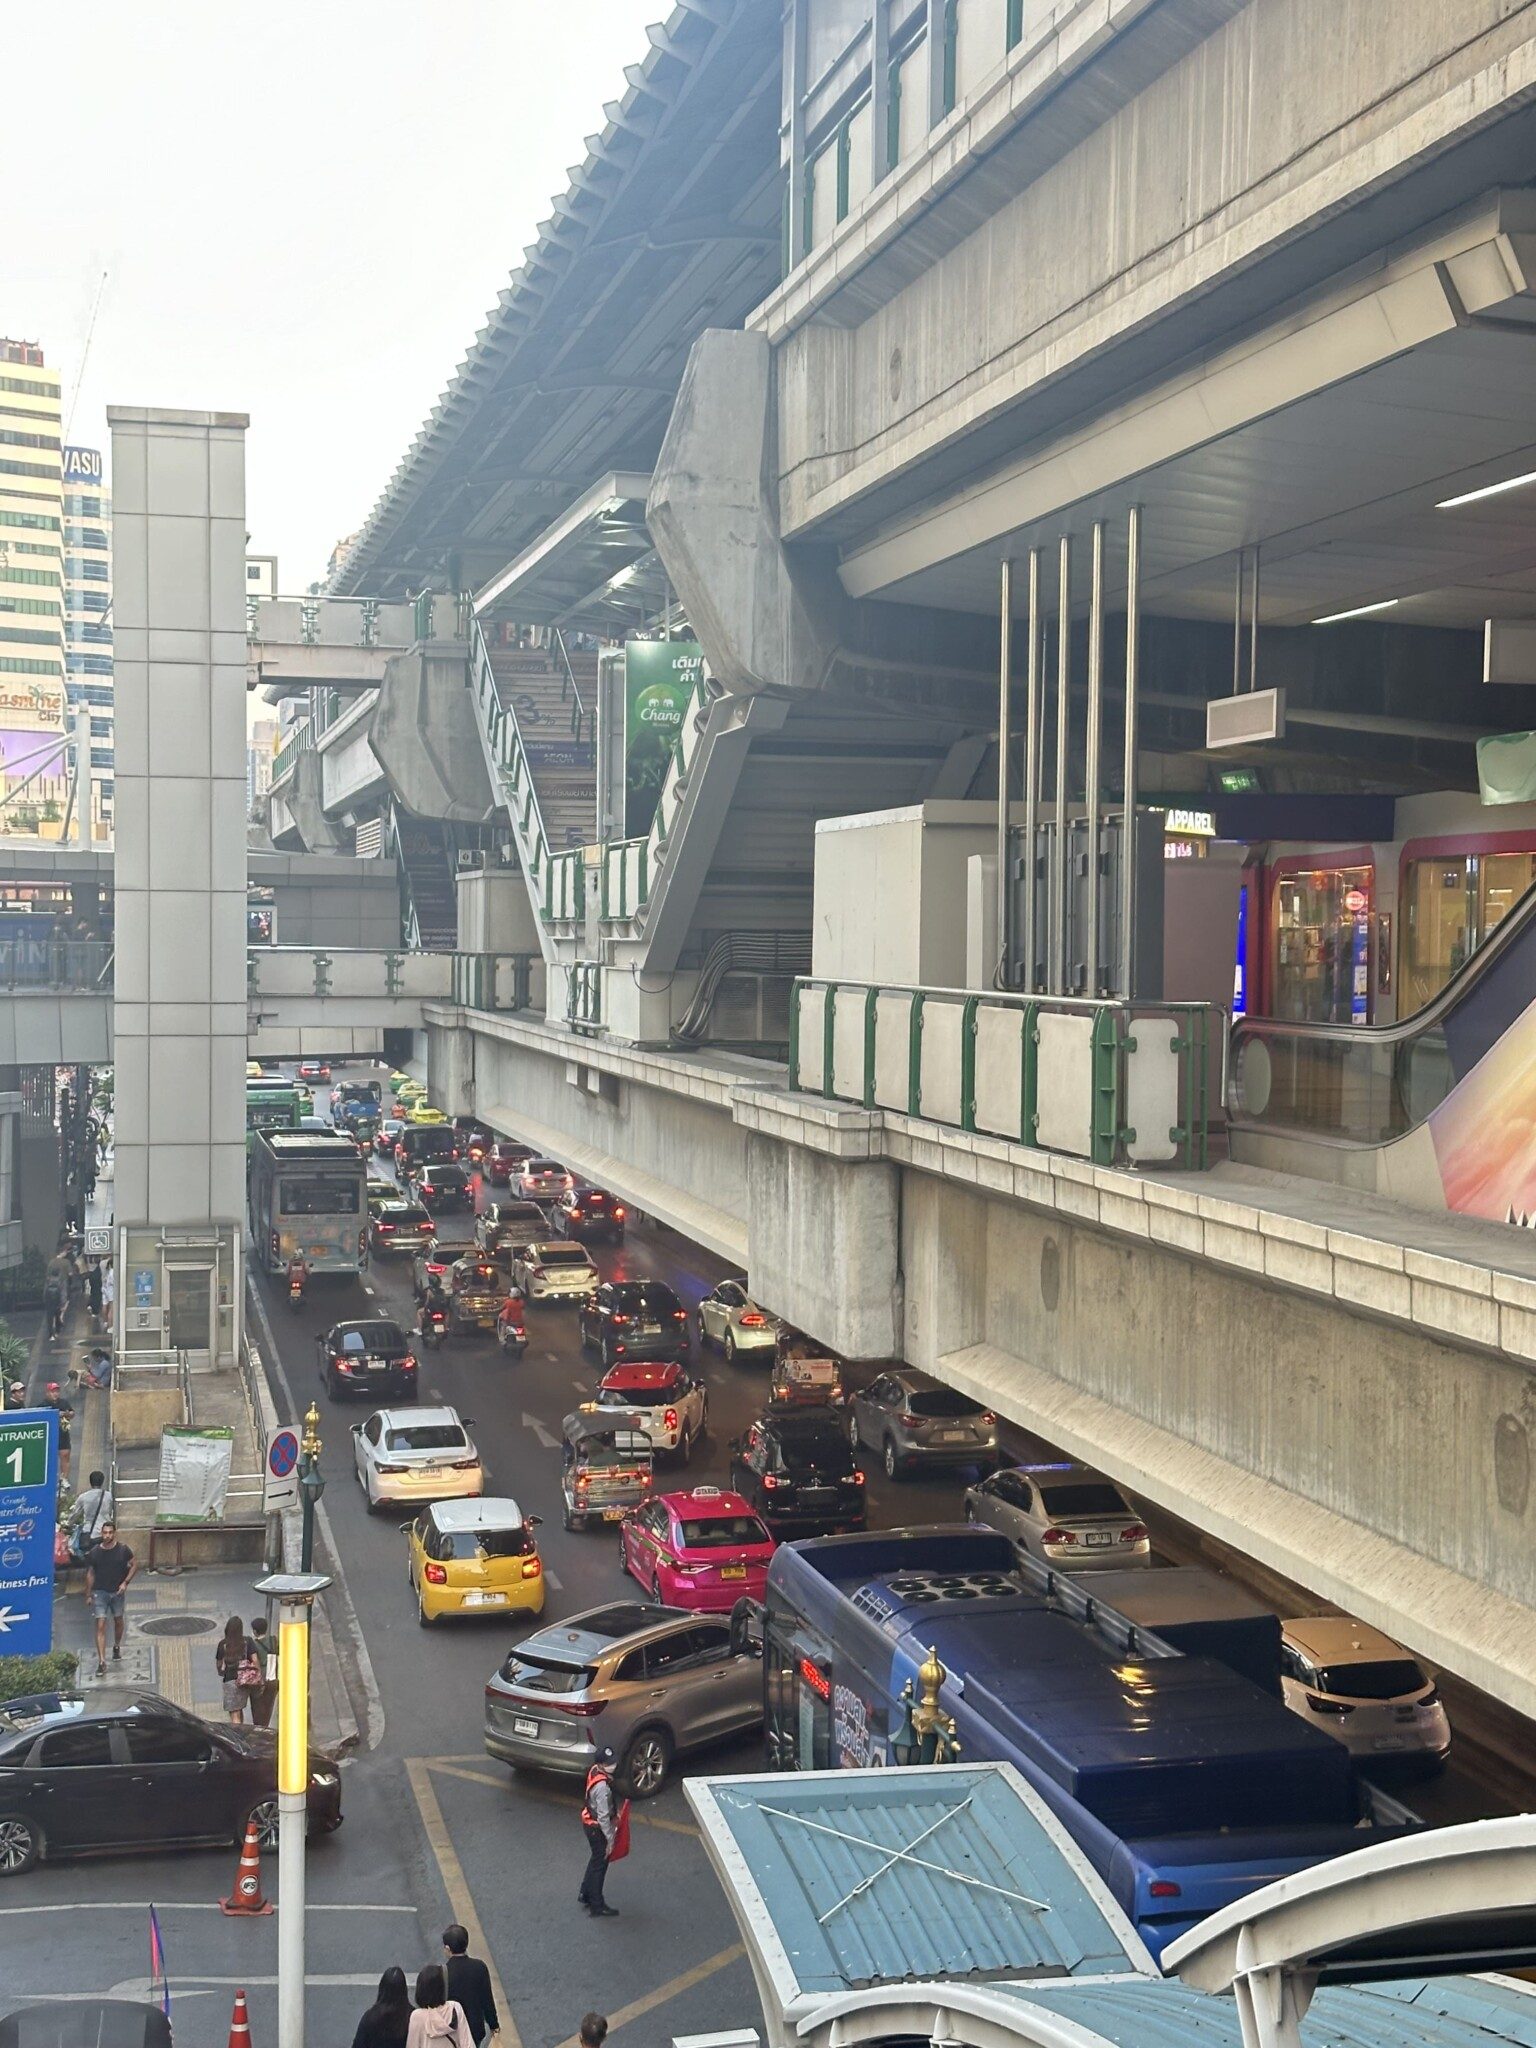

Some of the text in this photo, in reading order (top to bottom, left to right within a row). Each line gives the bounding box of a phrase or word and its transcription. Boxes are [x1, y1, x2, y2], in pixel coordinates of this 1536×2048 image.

[640, 708, 682, 723] Chang
[1167, 809, 1213, 832] APPAREL
[6, 1447, 23, 1483] 1
